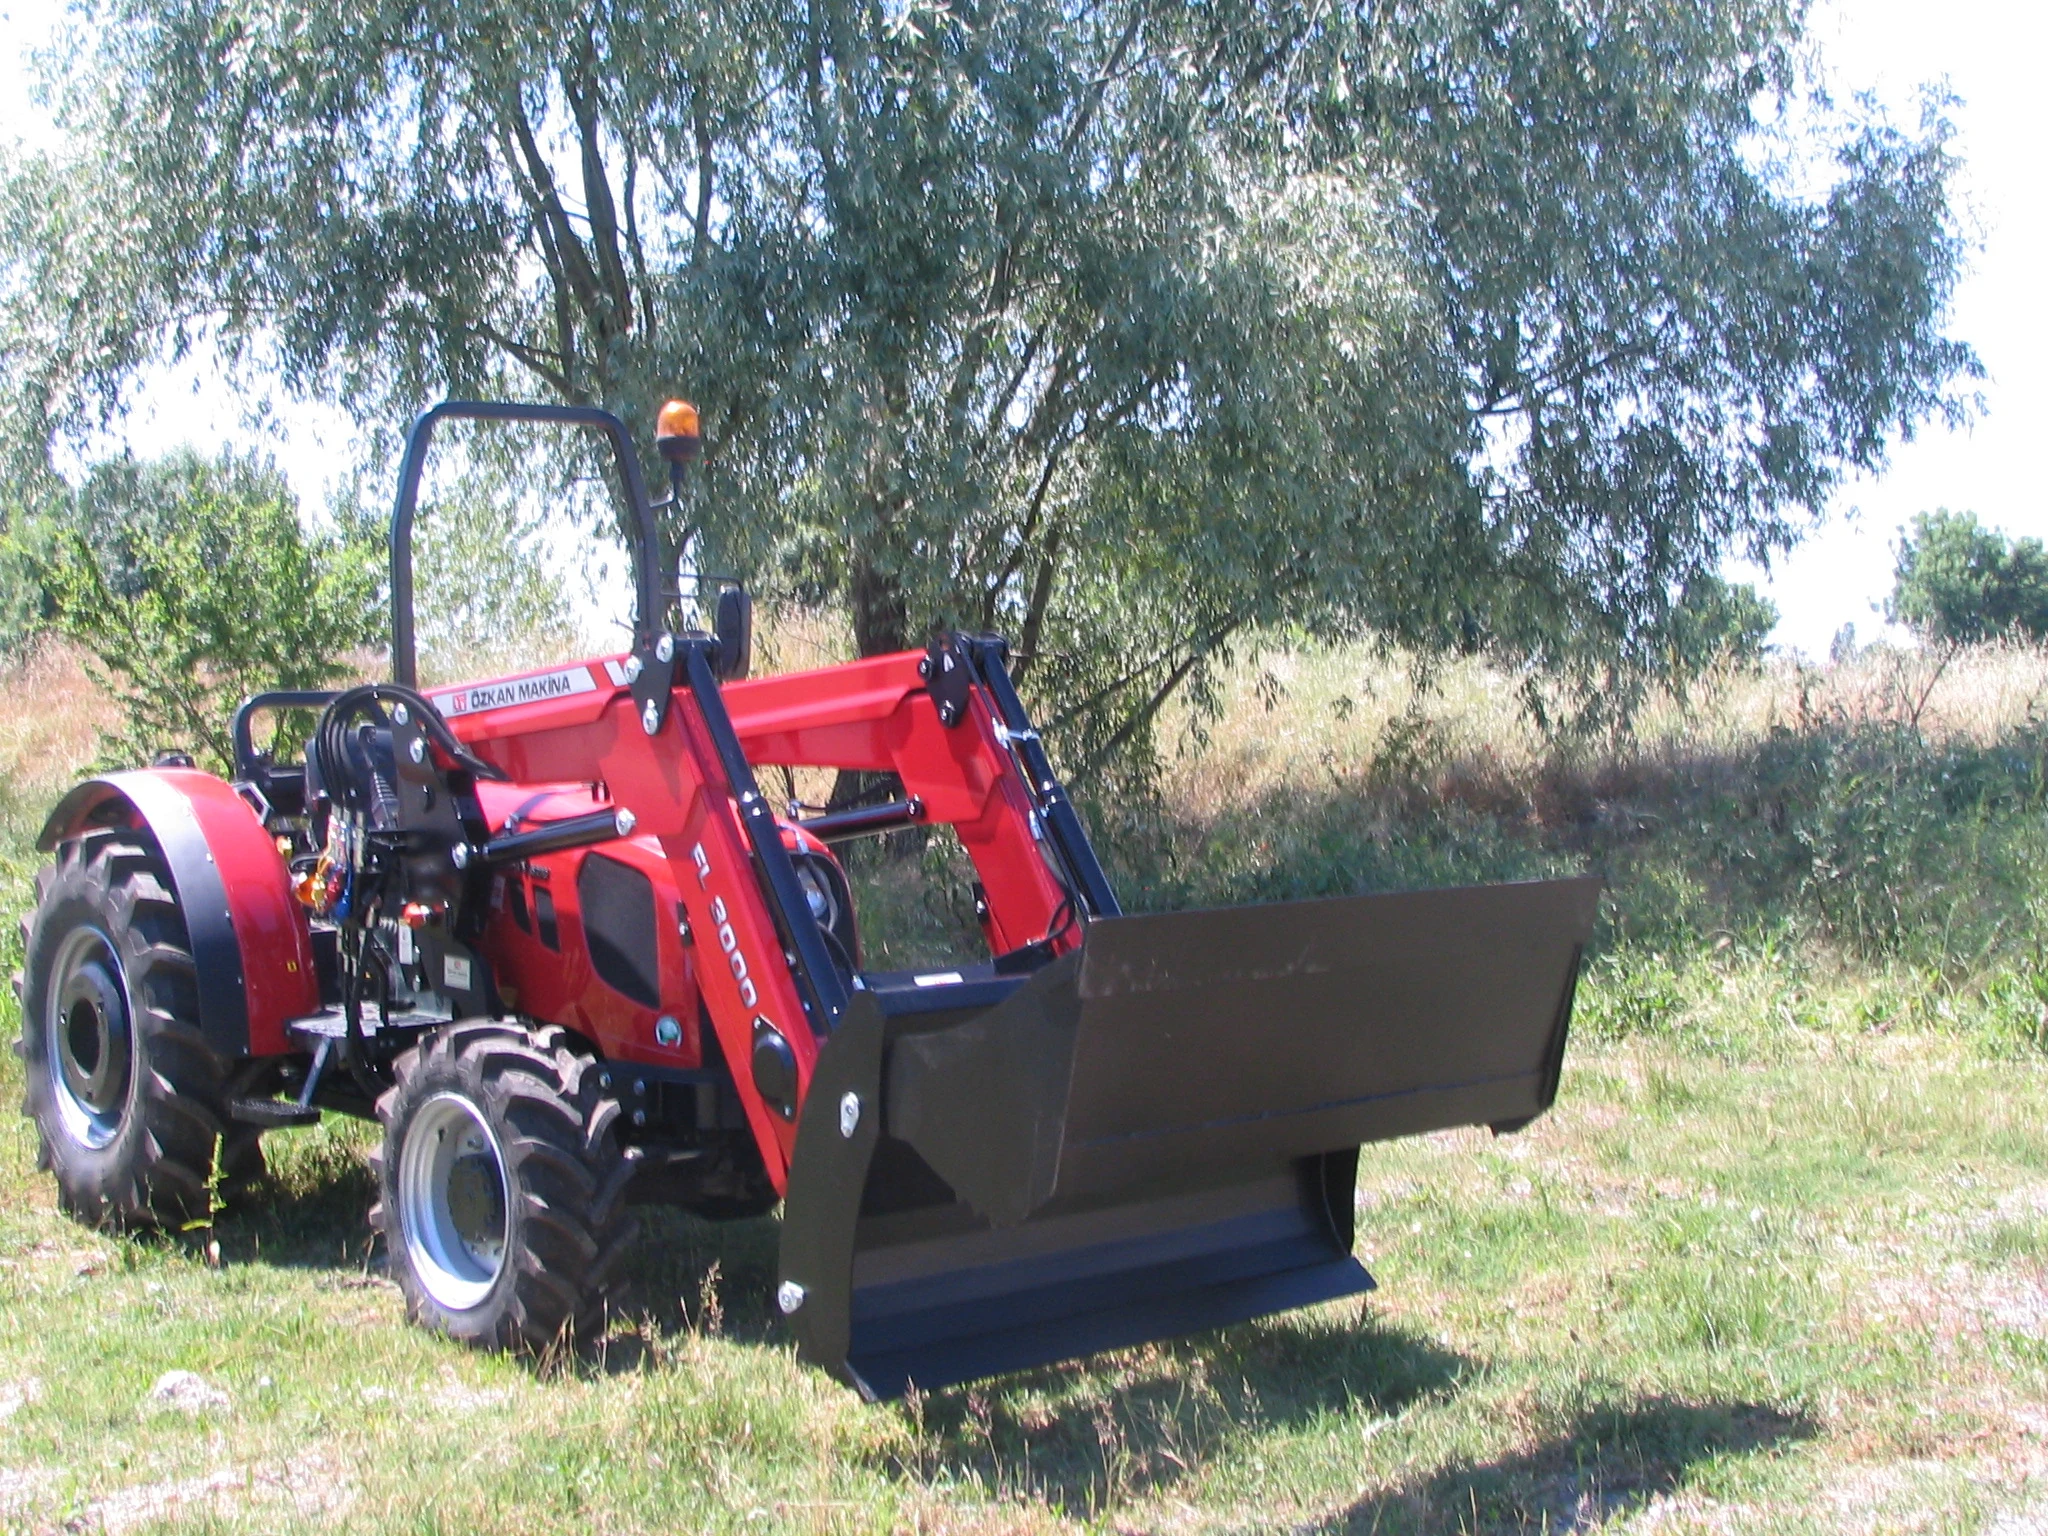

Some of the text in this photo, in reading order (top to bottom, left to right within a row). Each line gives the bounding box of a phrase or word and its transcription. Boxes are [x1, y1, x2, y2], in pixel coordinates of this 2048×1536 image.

[471, 675, 571, 709] ÖZKAN MAKİNA
[691, 842, 757, 1009] FL 3000
